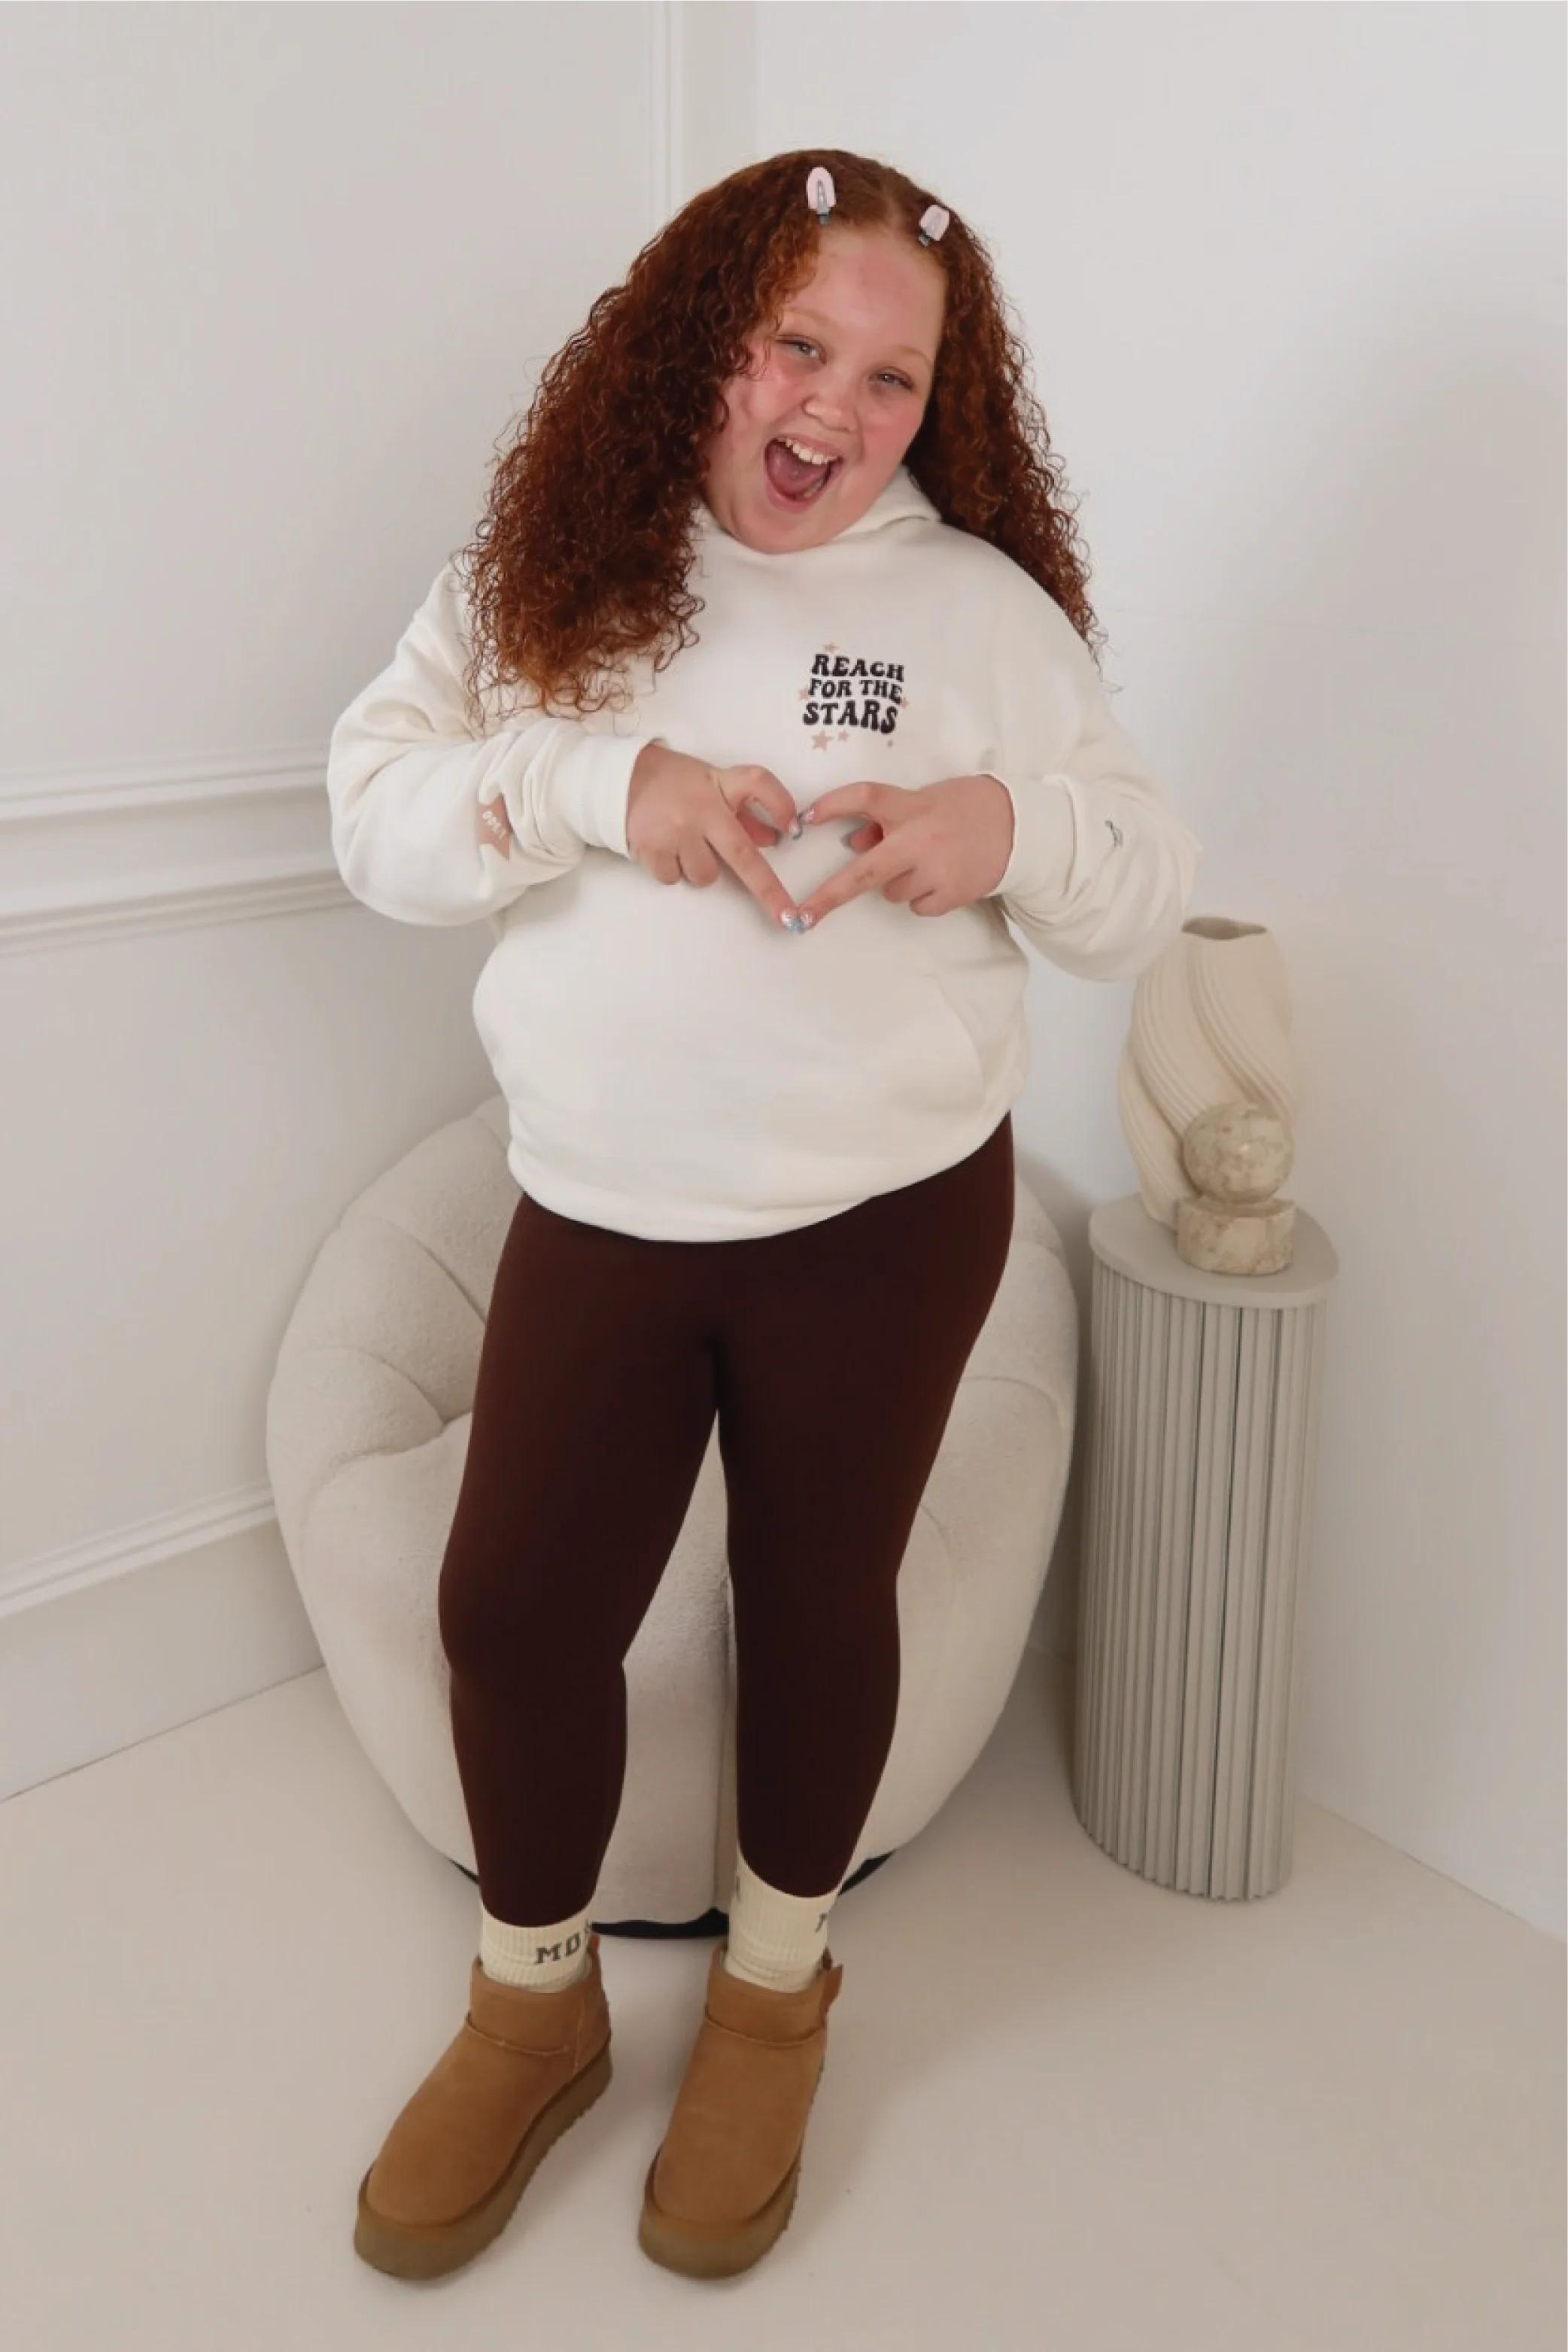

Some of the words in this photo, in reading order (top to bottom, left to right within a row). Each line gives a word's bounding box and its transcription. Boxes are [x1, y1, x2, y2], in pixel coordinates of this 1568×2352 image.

[811, 654, 904, 682] REACH
[808, 678, 852, 697] FOR
[858, 679, 903, 704] THE
[803, 699, 898, 734] STARS
